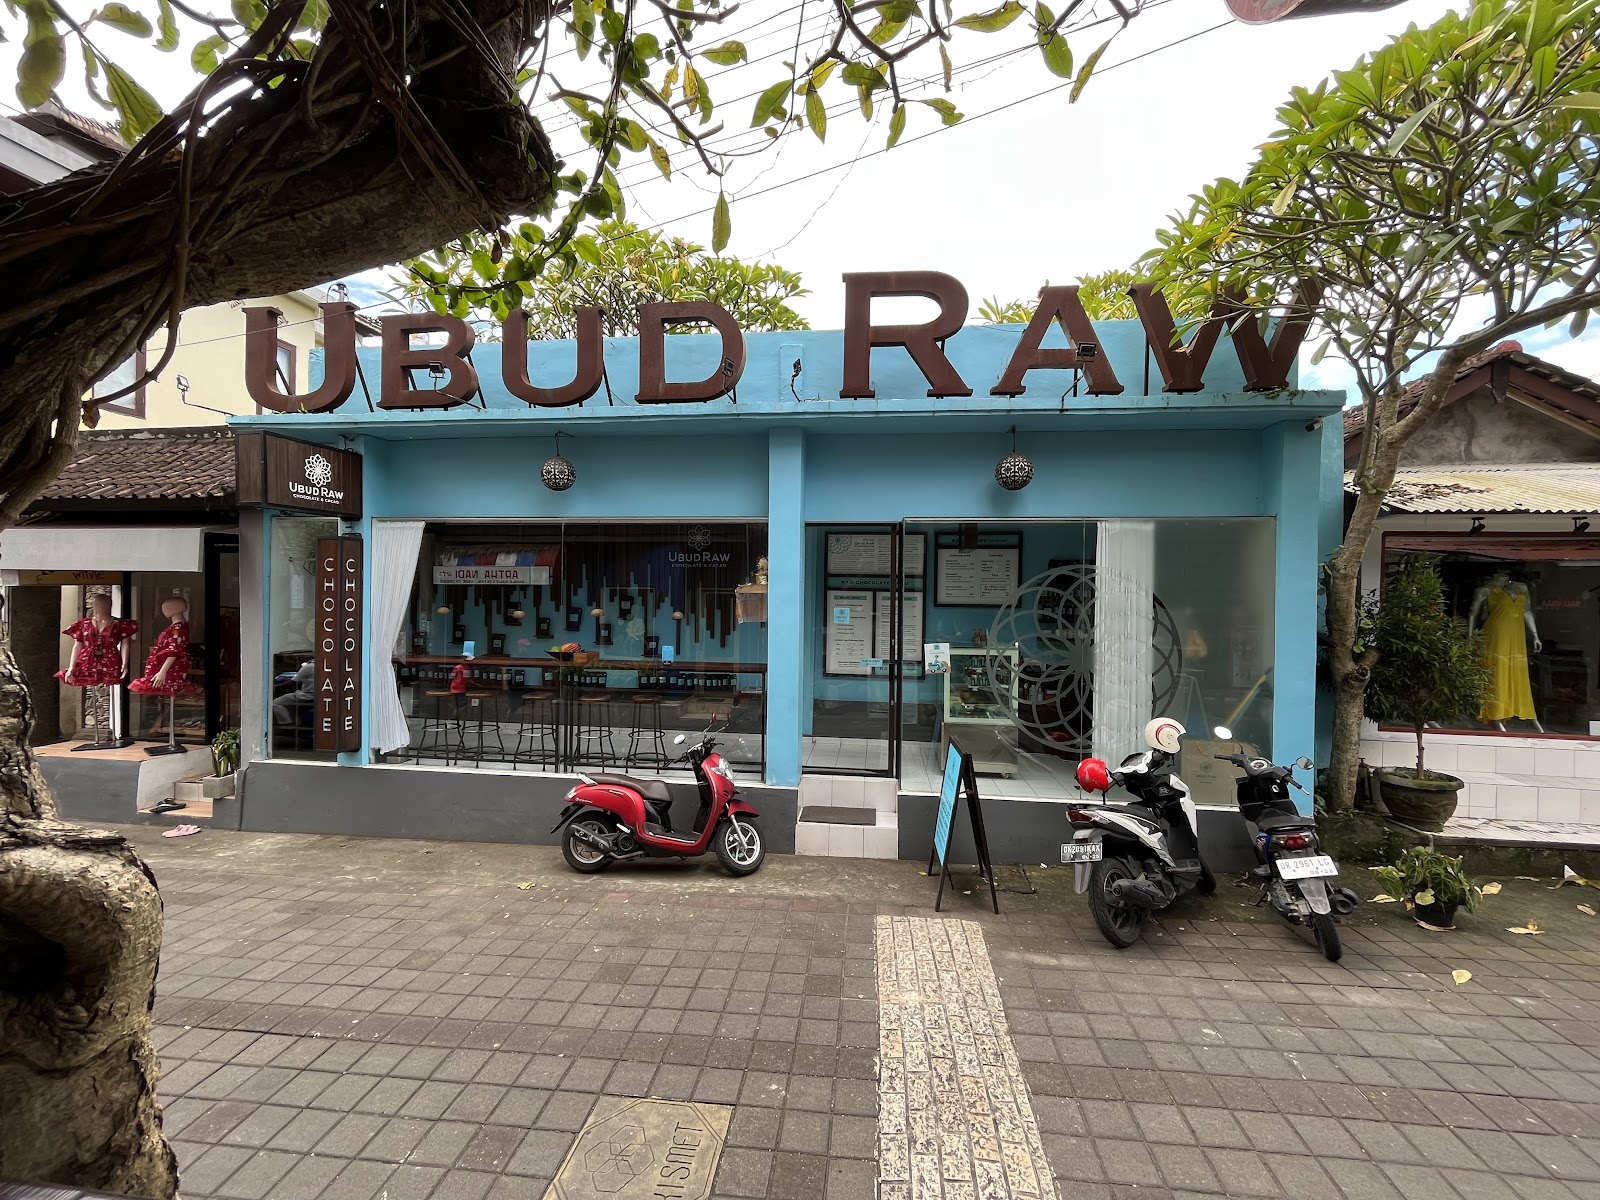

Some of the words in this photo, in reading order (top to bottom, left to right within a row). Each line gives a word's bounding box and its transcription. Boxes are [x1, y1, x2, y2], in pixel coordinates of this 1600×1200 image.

[242, 301, 746, 413] UBUD
[839, 270, 1324, 397] RAW
[288, 481, 320, 496] UBUD
[321, 487, 344, 500] RAW
[292, 493, 320, 501] CHOCOLATE
[668, 551, 701, 562] UBUD
[702, 551, 731, 562] RAW
[321, 557, 335, 732] CHOCOLATE
[343, 557, 357, 732] CHOCOLATE
[1293, 859, 1315, 869] 2961
